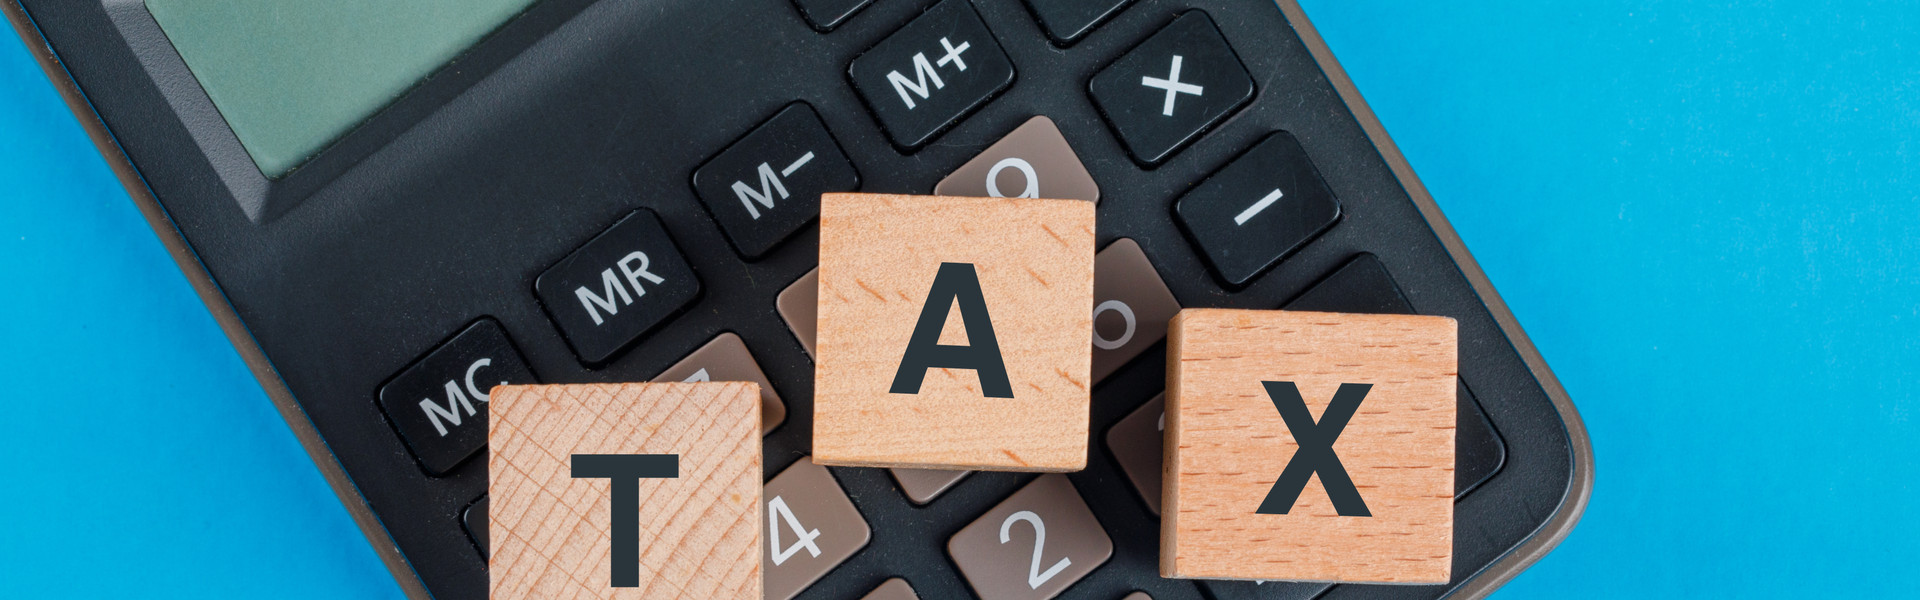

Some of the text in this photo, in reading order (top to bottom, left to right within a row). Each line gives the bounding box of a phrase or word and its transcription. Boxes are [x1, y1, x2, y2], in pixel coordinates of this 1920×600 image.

[886, 36, 970, 110] M+
[731, 151, 815, 220] M-
[574, 250, 665, 326] MR
[418, 357, 509, 437] MC
[571, 262, 1375, 588] T A X
[768, 495, 822, 567] 4
[1000, 510, 1072, 590] 2
